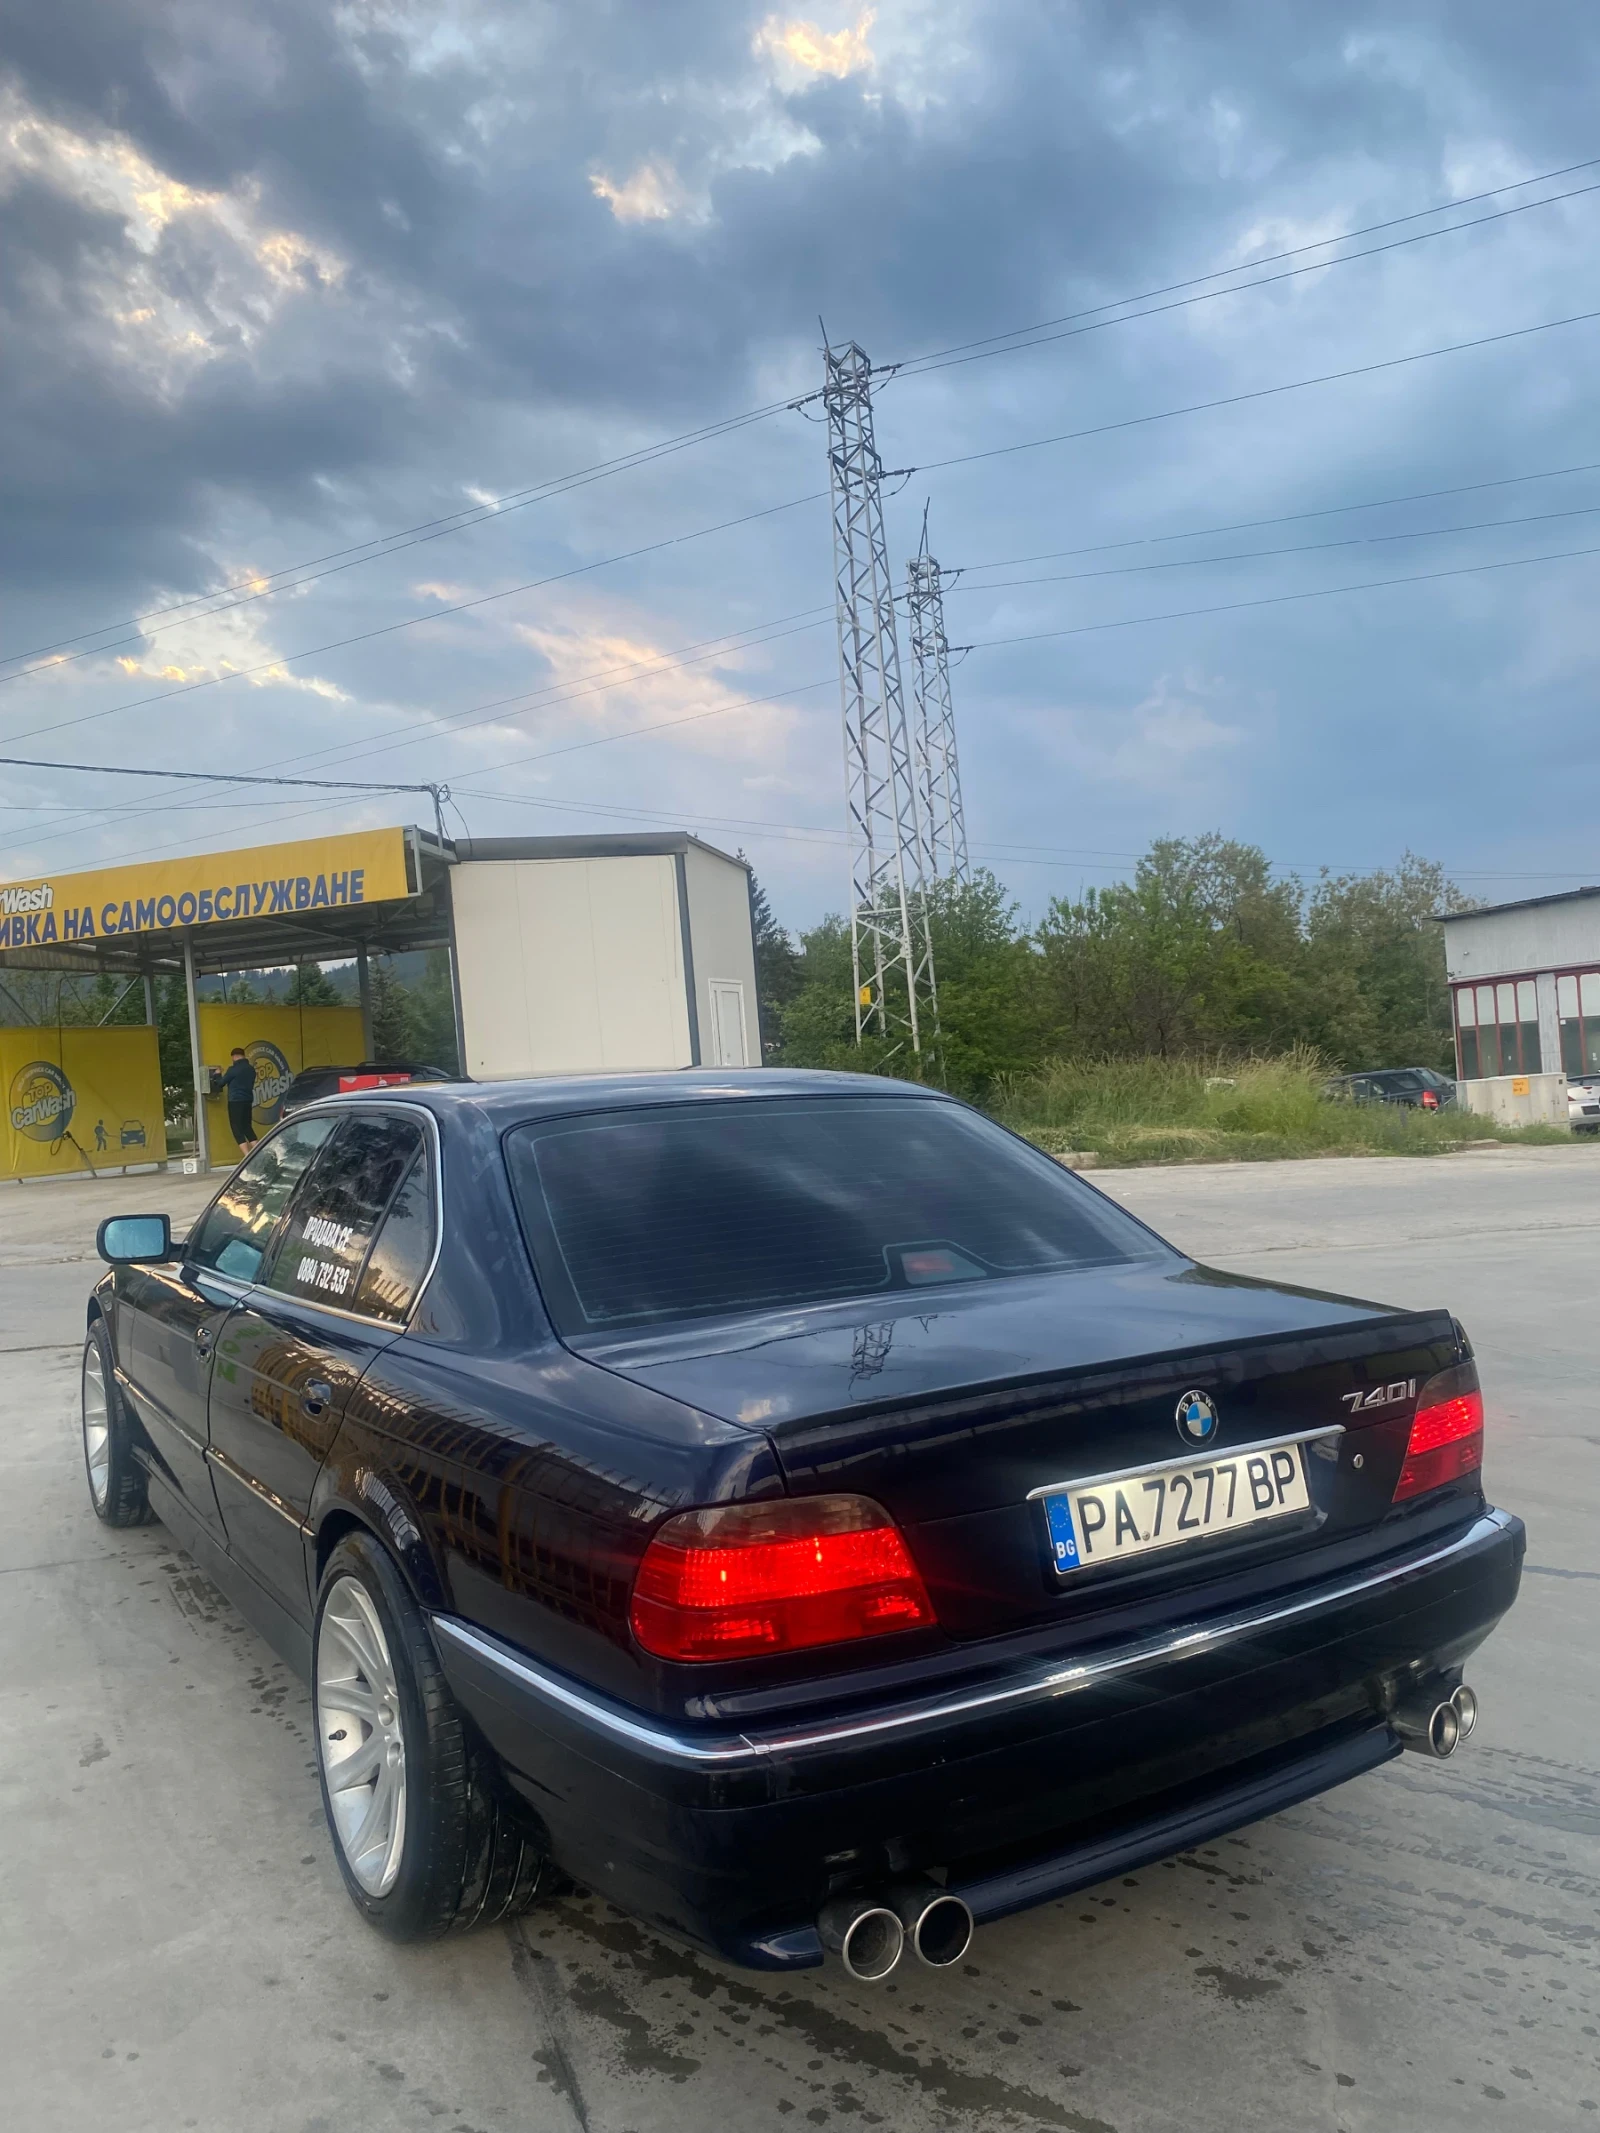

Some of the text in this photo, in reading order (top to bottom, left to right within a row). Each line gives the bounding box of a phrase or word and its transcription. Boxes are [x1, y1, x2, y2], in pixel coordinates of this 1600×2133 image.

[64, 907, 96, 940] НА
[101, 869, 364, 934] САМООБСЛУЖВАНЕ
[28, 1081, 53, 1103] TOP
[12, 1088, 76, 1130] CarWash
[329, 1266, 350, 1295] 533
[1180, 1392, 1213, 1413] BMW
[1056, 1539, 1076, 1559] BG
